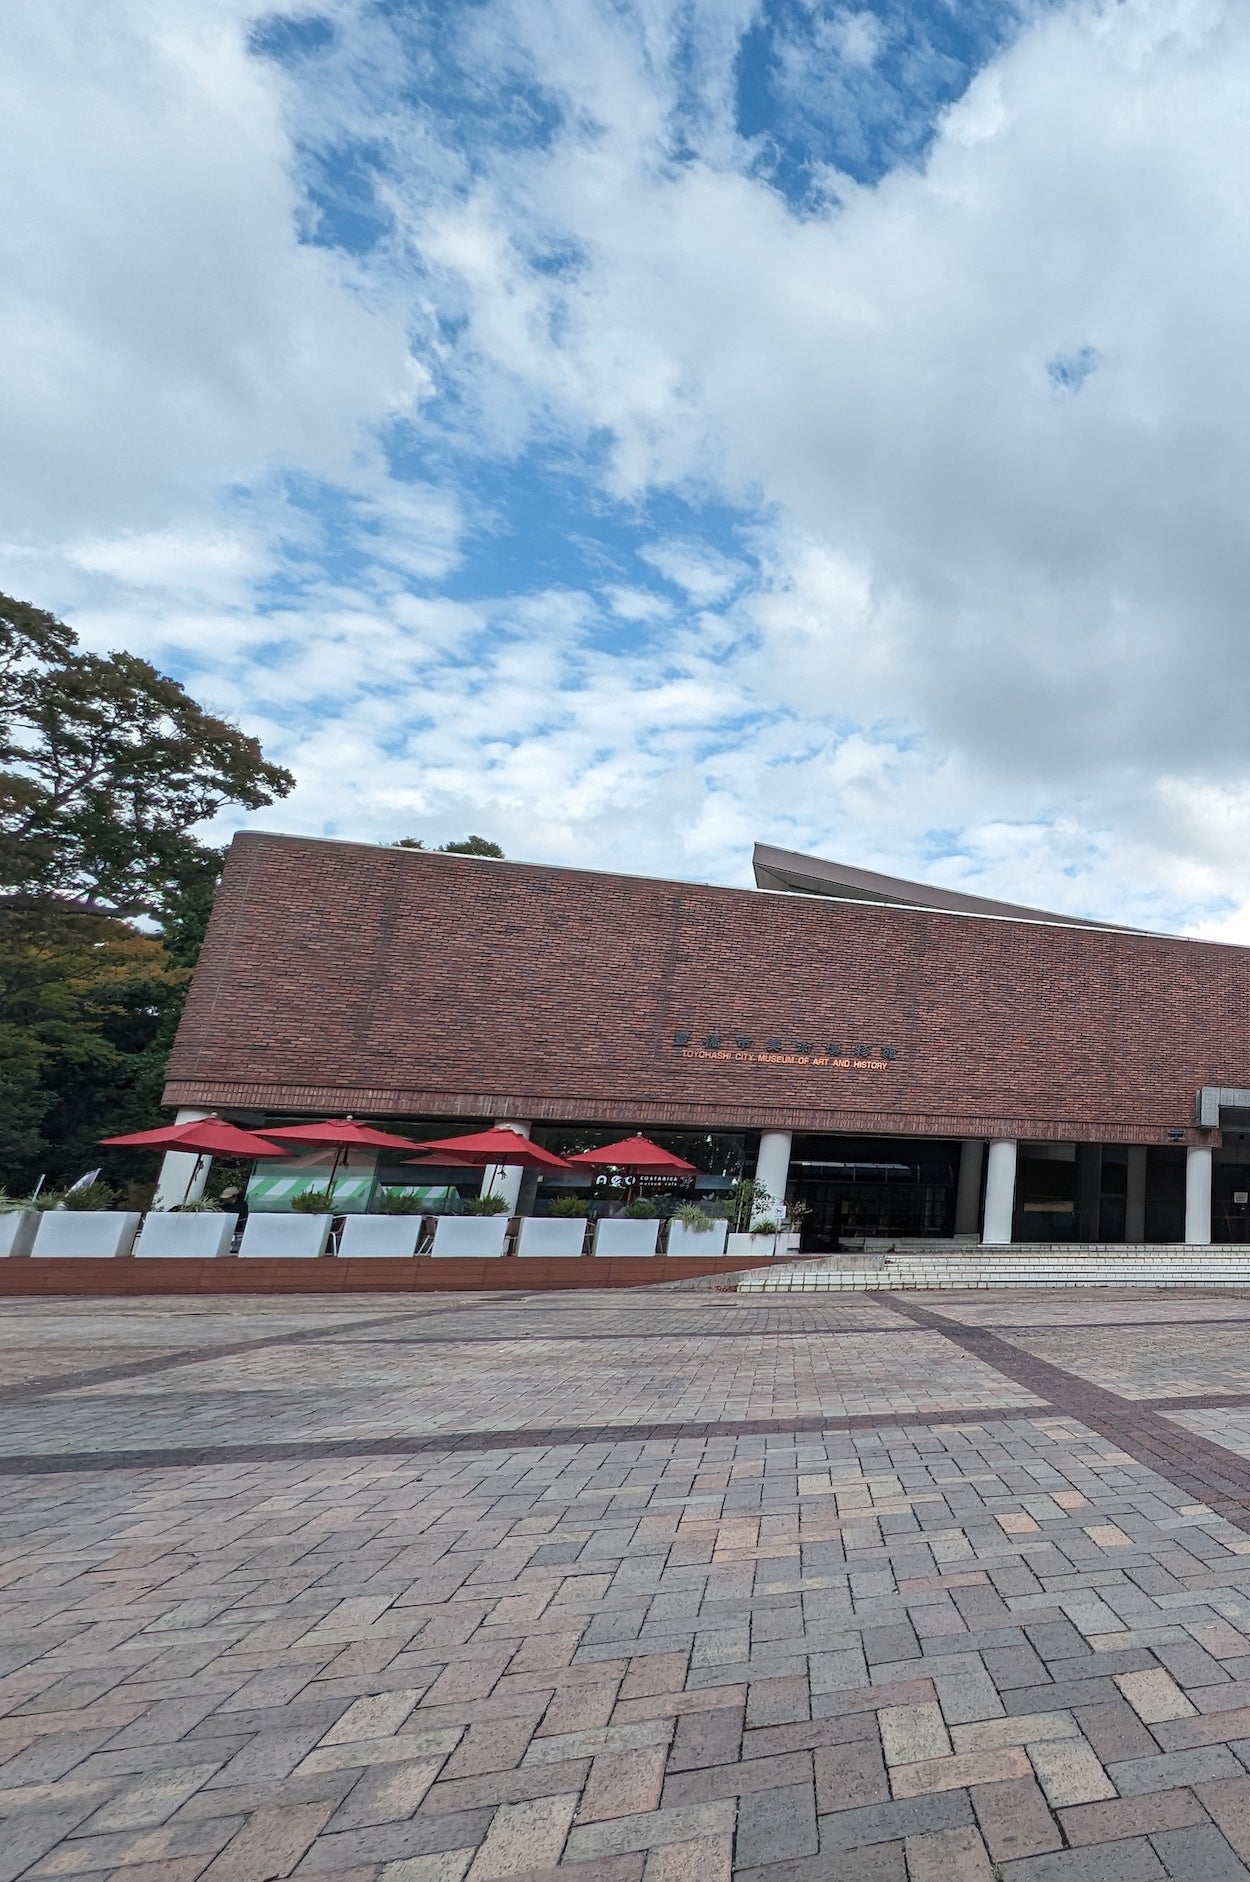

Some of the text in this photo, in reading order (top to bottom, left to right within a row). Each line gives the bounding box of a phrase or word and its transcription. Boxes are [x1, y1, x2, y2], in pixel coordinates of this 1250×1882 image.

[682, 1049, 888, 1070] TOYOHASHI CITY MUSEUM OF ART AND HISTORY
